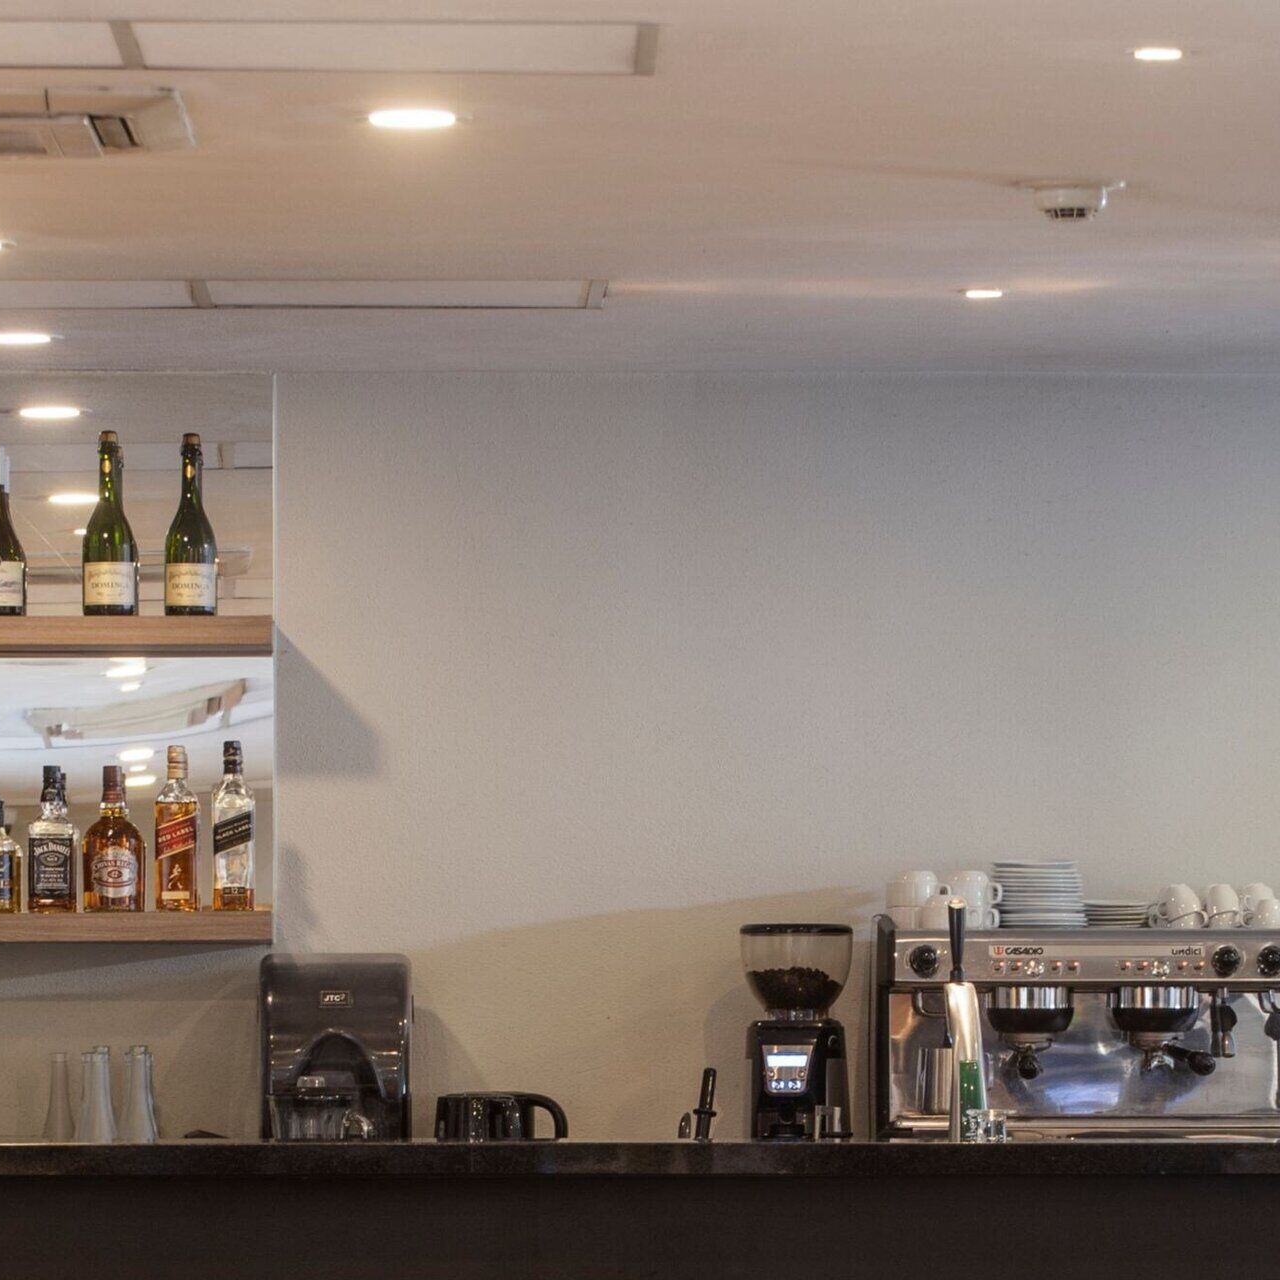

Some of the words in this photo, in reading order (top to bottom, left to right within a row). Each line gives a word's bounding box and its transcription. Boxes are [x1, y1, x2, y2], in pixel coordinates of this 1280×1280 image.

[173, 826, 195, 838] LABEL
[1005, 946, 1044, 956] CASADIO
[1171, 946, 1203, 956] undici
[324, 994, 341, 1002] JTC
